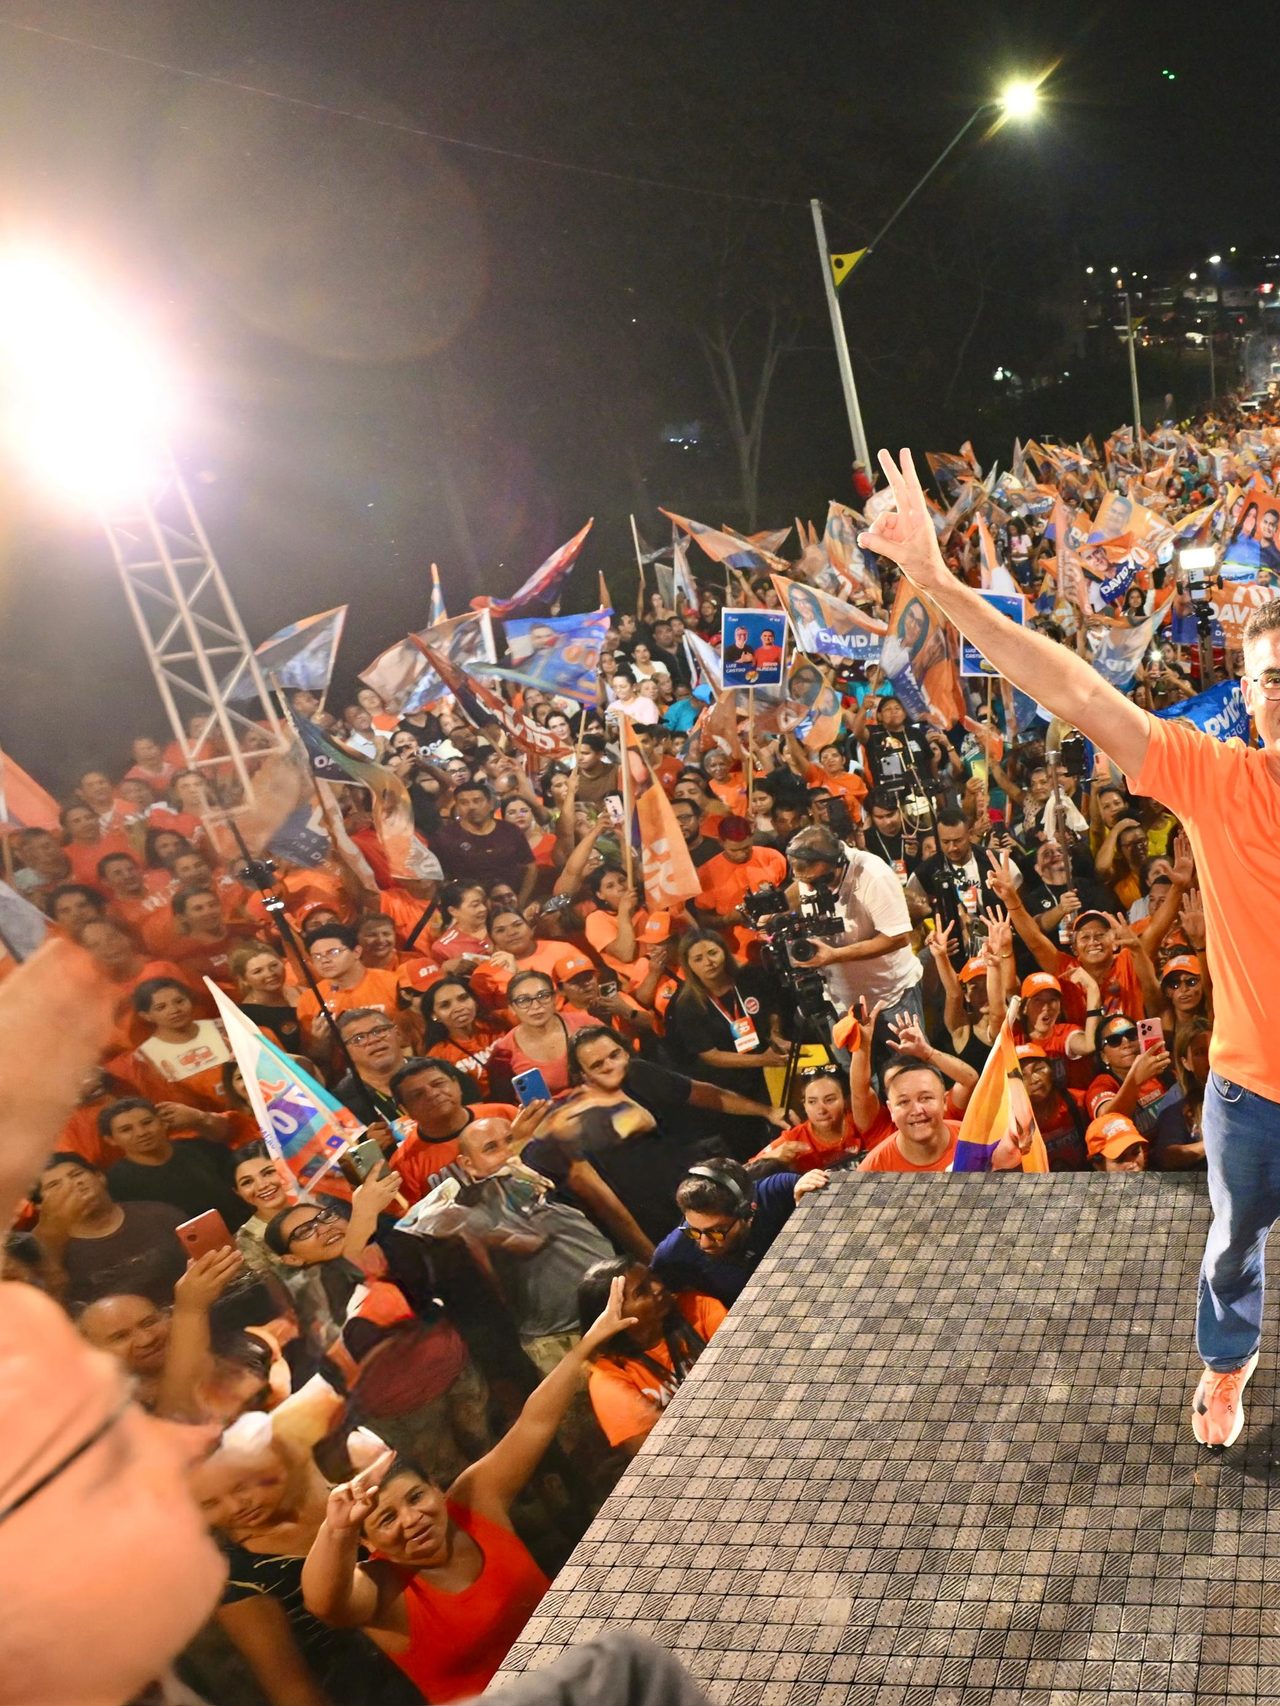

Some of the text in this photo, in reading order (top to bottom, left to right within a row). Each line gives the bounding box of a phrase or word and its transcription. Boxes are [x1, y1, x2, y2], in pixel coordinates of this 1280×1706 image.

[1118, 546, 1150, 570] 70
[1101, 568, 1129, 595] DAVID
[1208, 602, 1252, 624] DAV
[819, 631, 869, 648] DAVID
